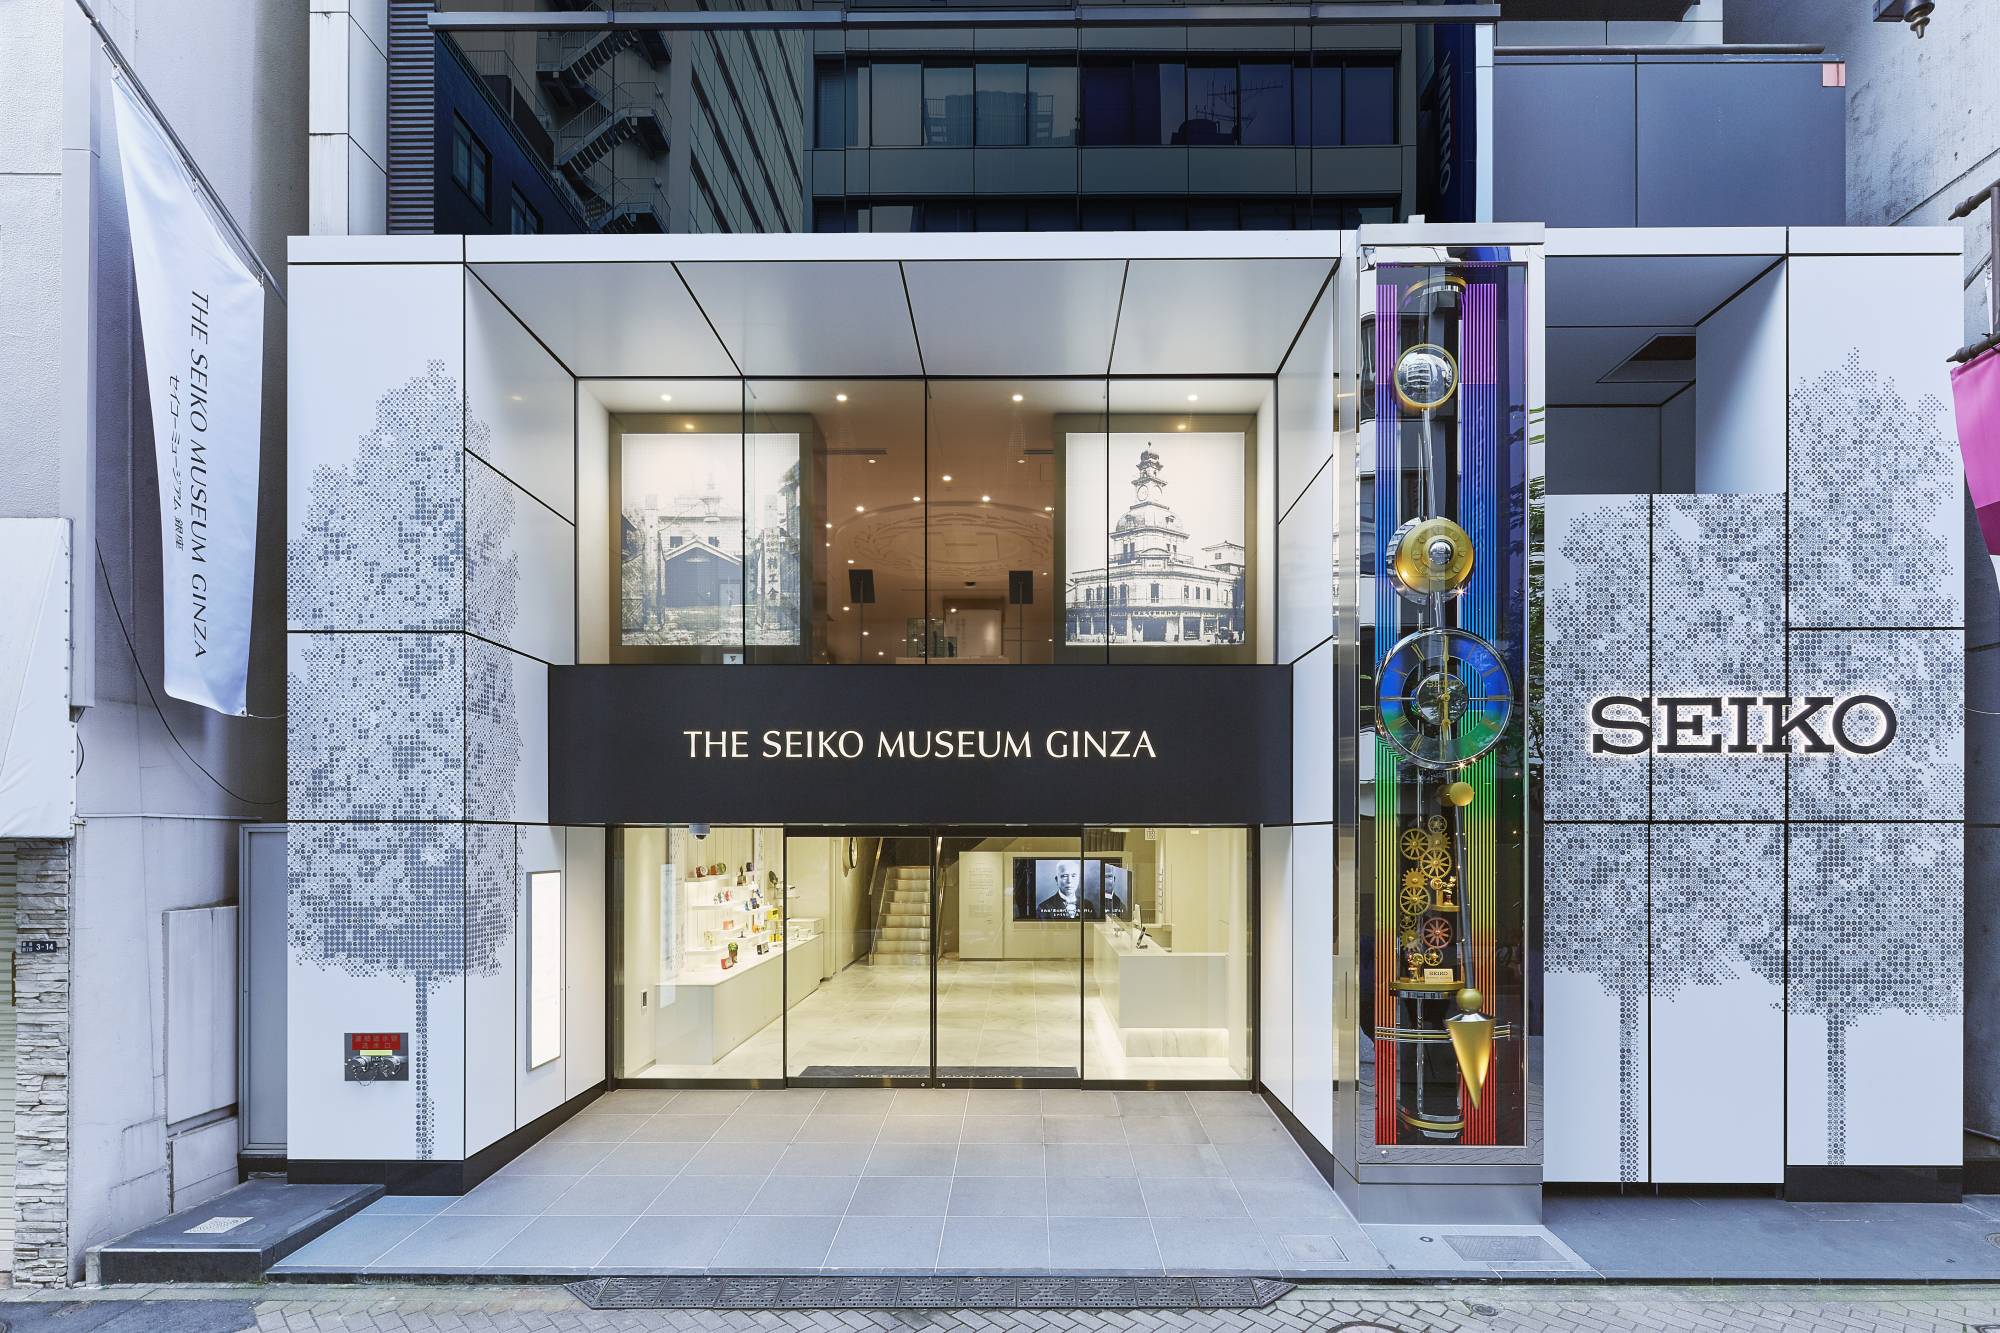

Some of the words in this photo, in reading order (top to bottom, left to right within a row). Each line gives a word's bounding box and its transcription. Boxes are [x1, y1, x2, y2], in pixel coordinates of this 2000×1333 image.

[191, 290, 209, 345] THE
[190, 348, 208, 433] SEIKO
[169, 375, 183, 511] セイコーミュージアム
[190, 438, 207, 563] MUSEUM
[174, 517, 184, 552] 銀座
[191, 573, 207, 658] GINZA
[683, 730, 749, 758] THE
[762, 730, 864, 758] SEIKO
[877, 730, 1032, 758] MUSEUM
[1046, 730, 1156, 759] GINZA
[1591, 694, 1897, 755] SEIKO
[36, 943, 54, 951] 3-14
